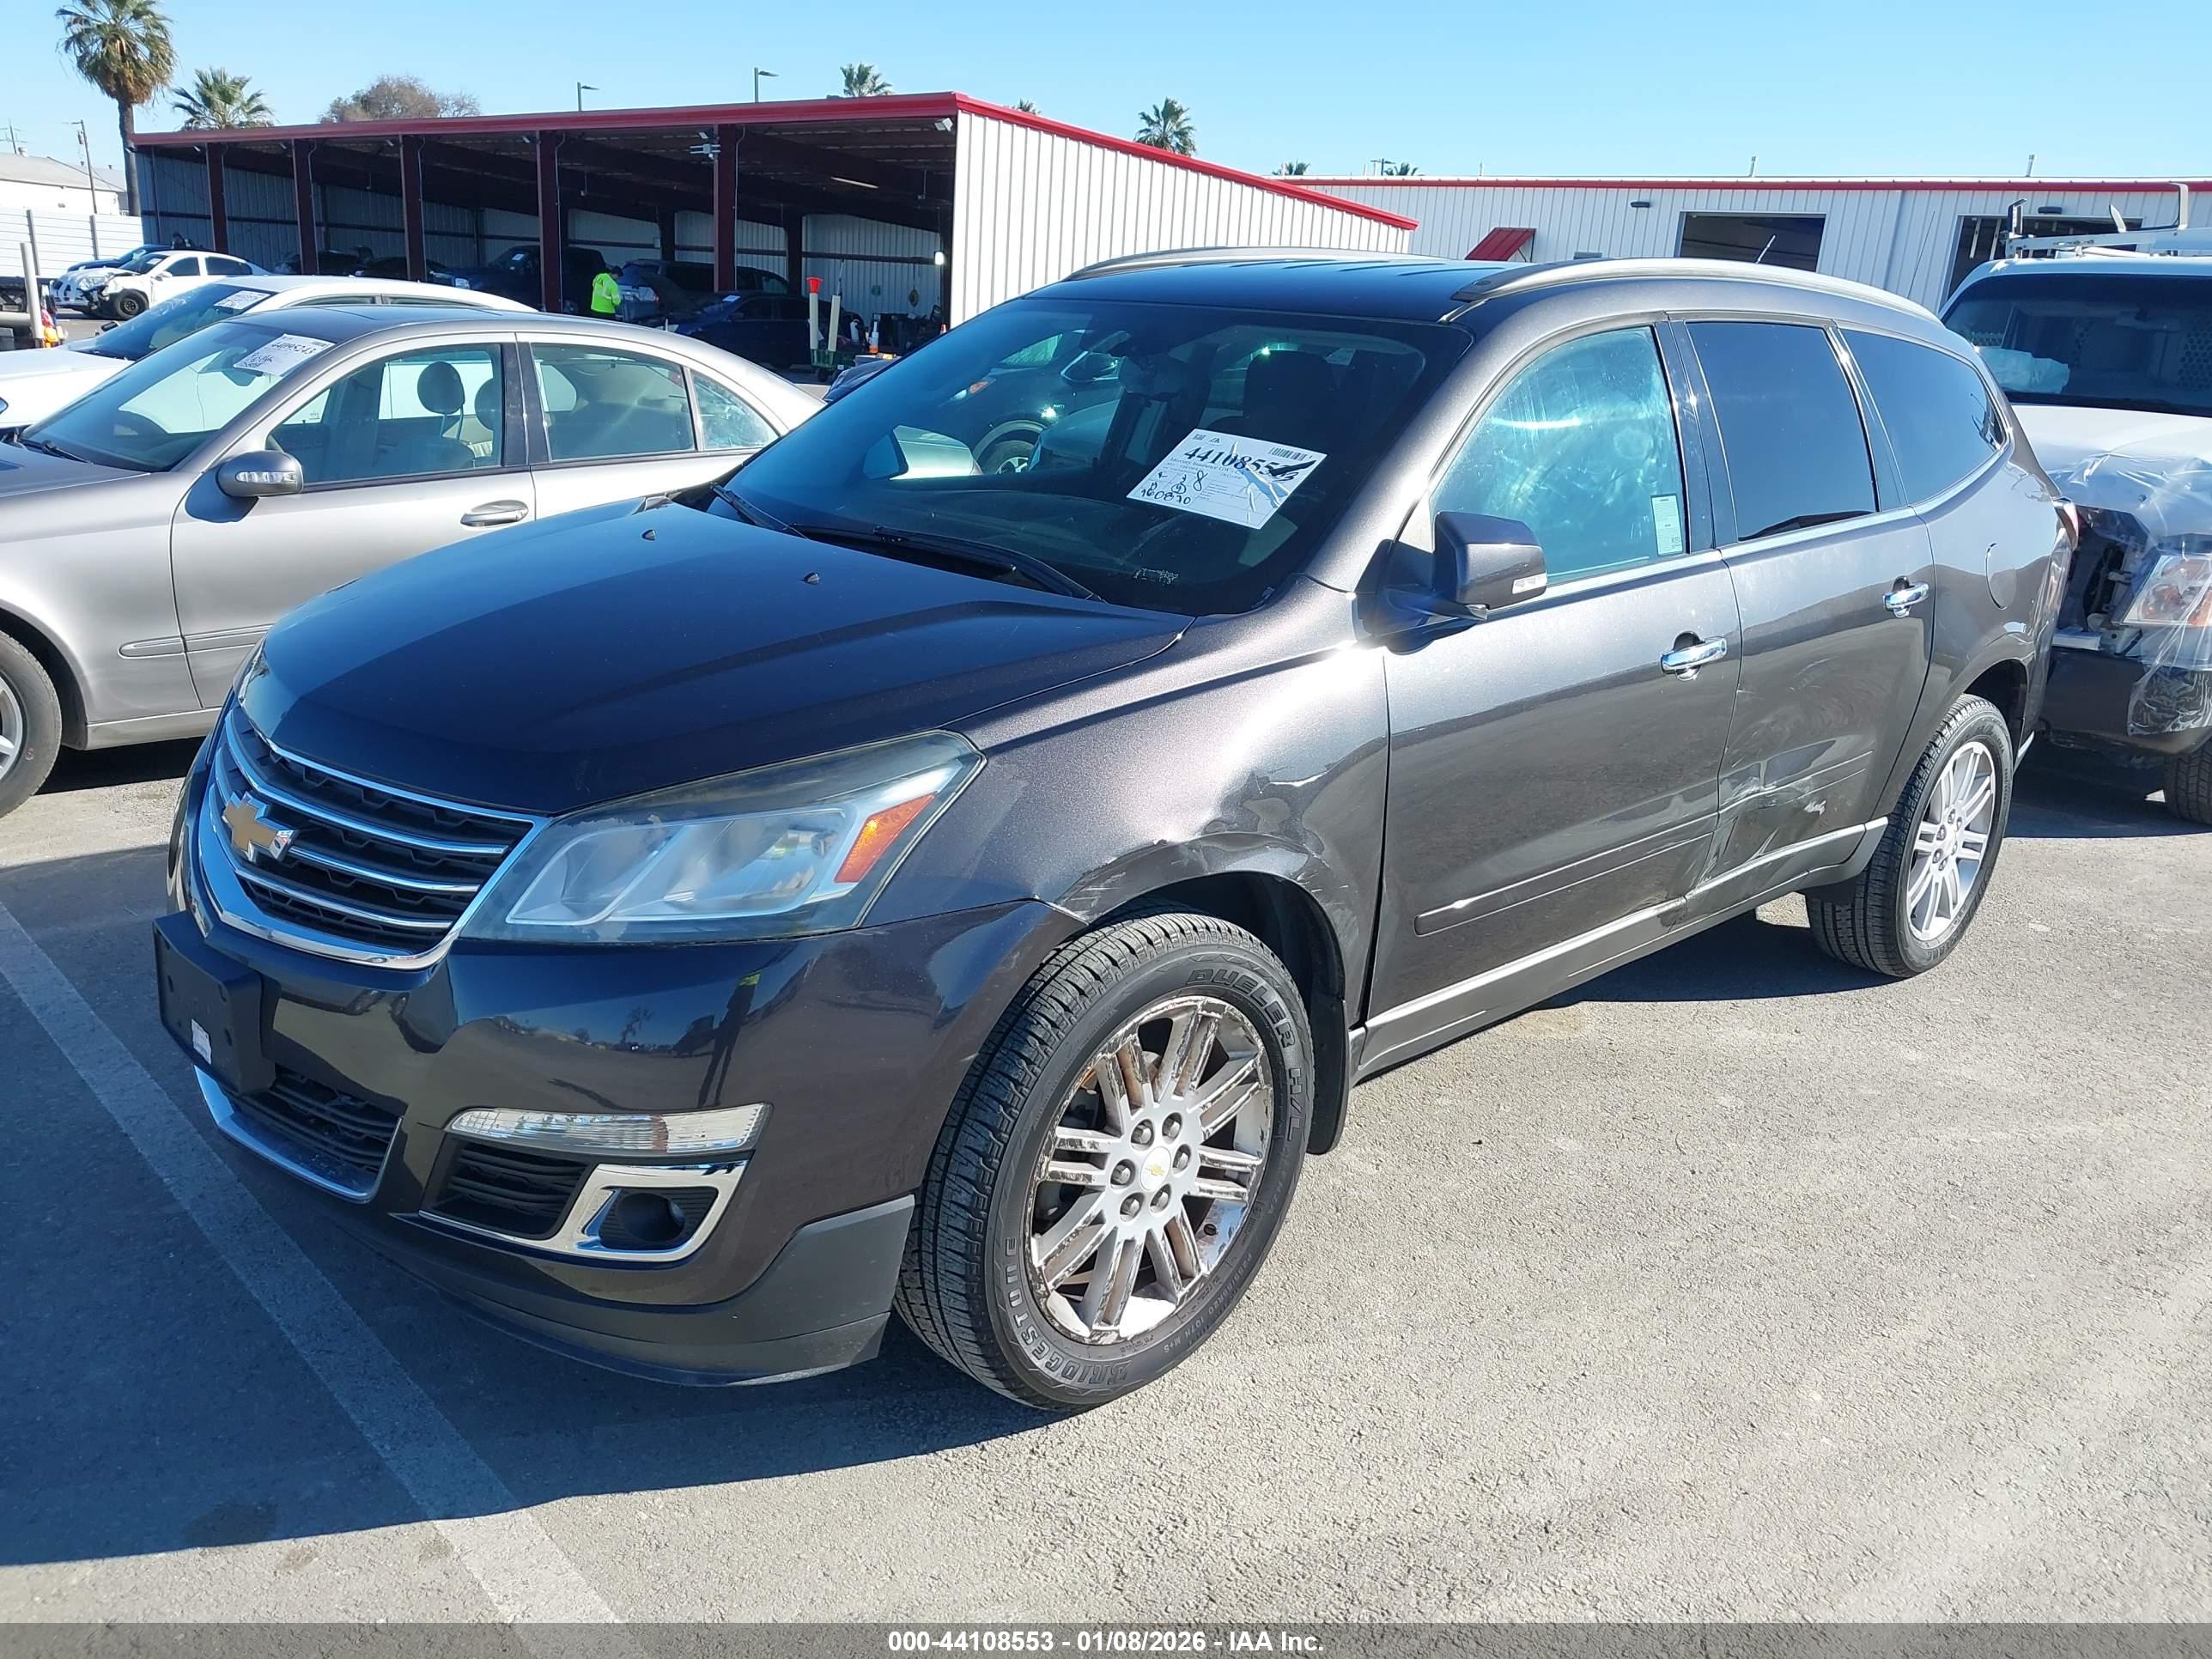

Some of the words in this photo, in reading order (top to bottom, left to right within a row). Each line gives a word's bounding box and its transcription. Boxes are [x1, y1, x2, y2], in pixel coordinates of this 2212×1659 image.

[1186, 968, 1296, 1048] DUELER
[1287, 1067, 1302, 1141] H/L
[1006, 1237, 1131, 1385] BRIDGESTONE
[1164, 1337, 1182, 1353] M+S
